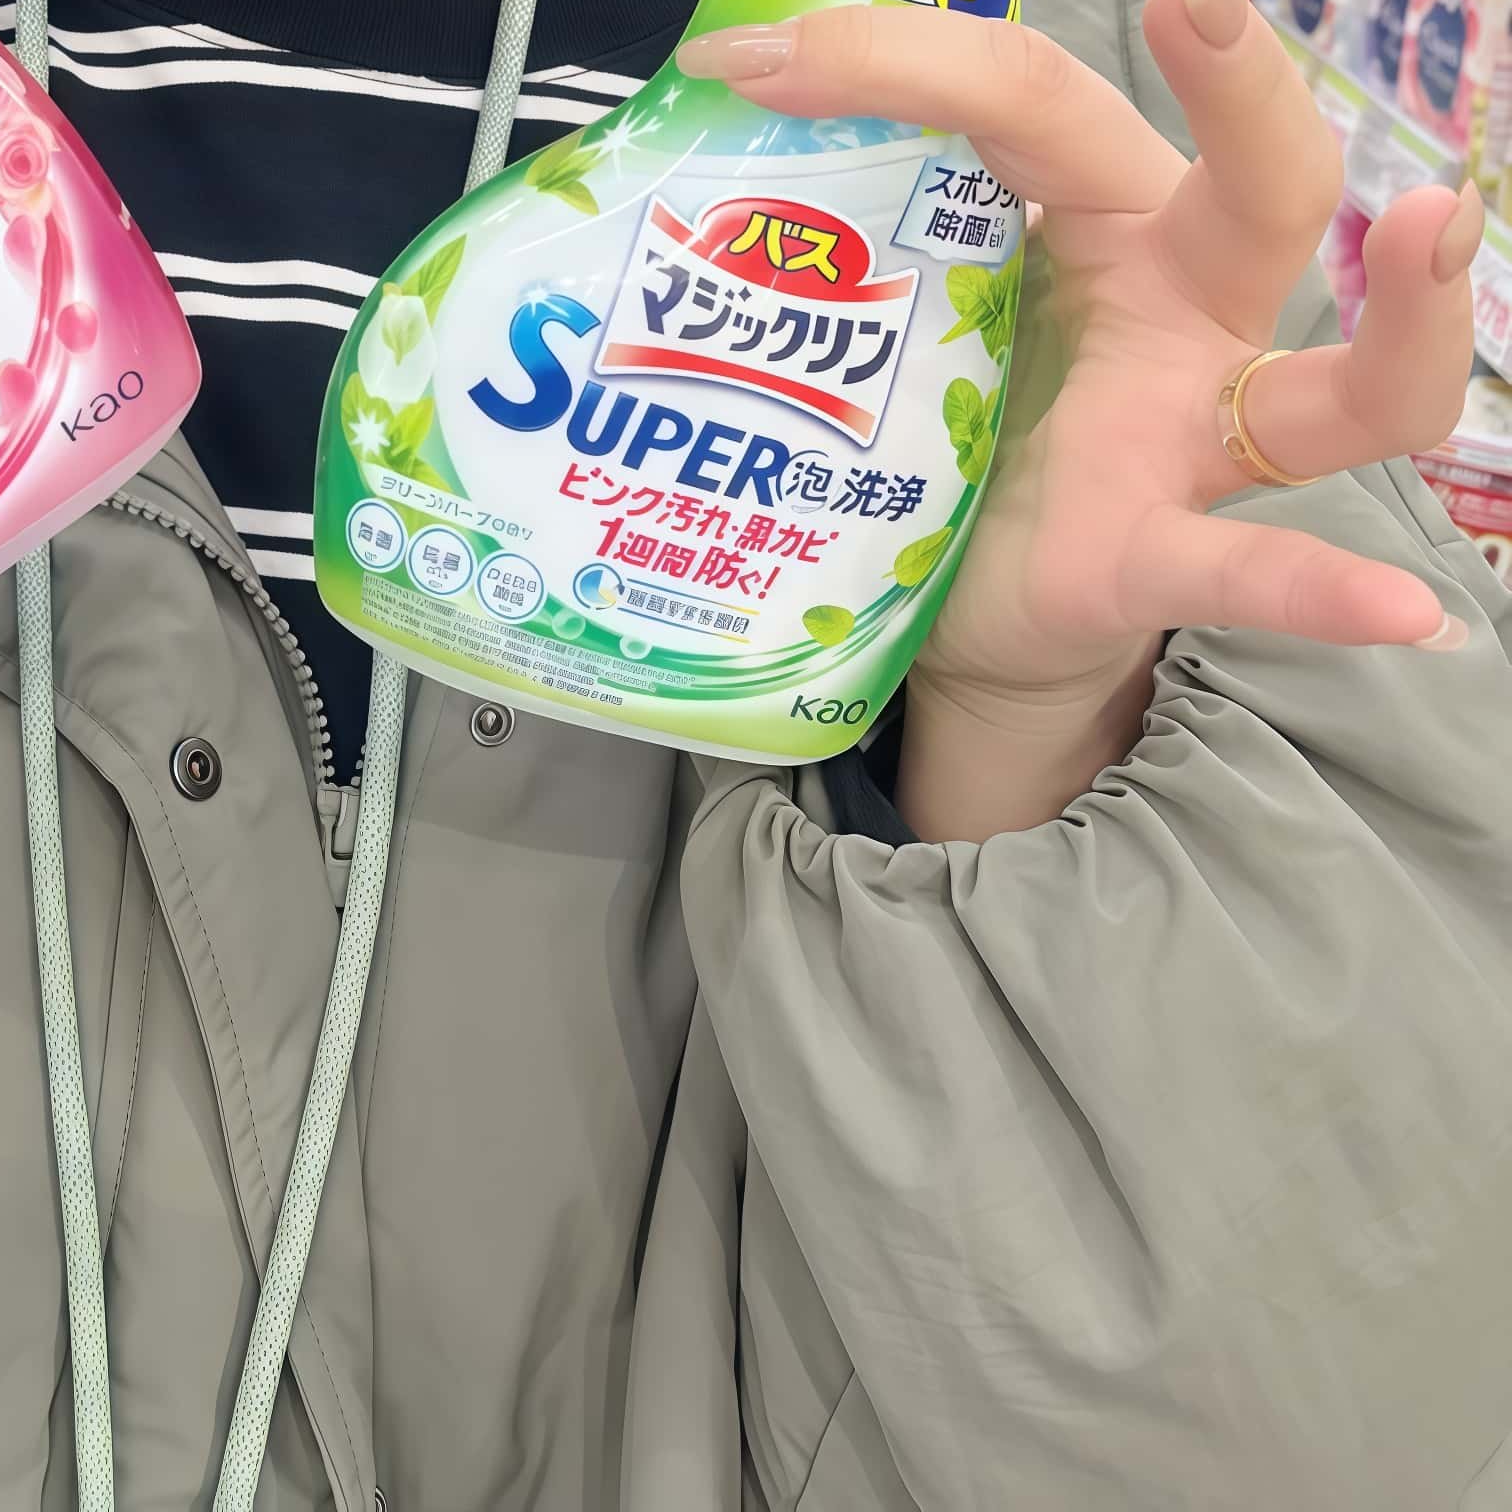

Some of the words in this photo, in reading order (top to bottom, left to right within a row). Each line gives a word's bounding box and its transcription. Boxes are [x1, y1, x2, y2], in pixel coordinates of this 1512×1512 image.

[728, 211, 841, 285] バス
[640, 250, 898, 386] マジックリン
[466, 293, 790, 509] SUPER
